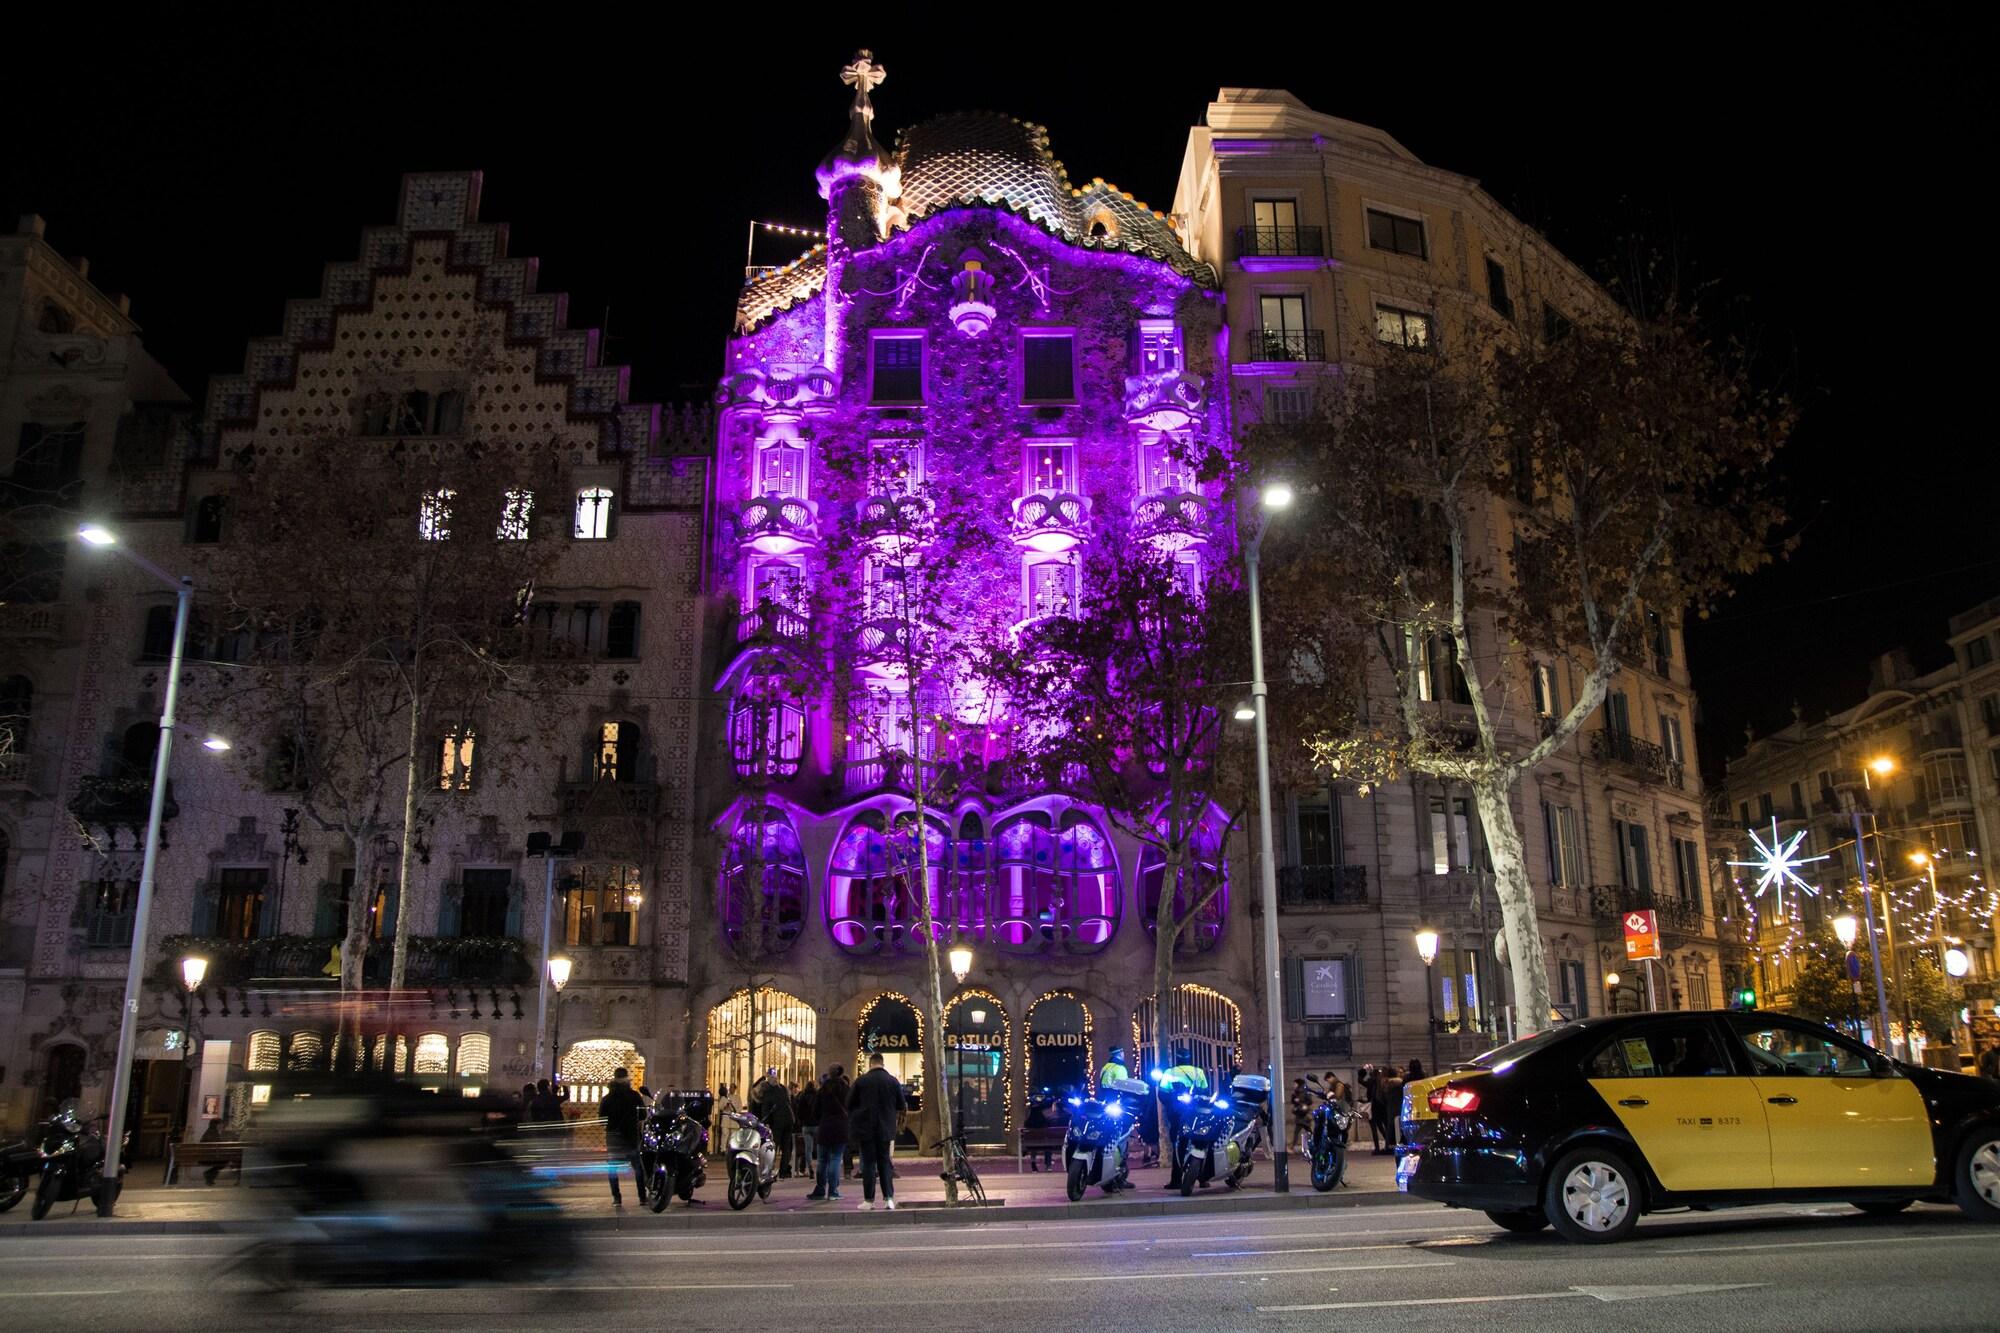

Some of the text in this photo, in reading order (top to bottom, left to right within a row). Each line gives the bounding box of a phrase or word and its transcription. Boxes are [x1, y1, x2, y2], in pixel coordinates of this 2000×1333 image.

[1631, 918, 1640, 926] M
[870, 1034, 909, 1047] CASA
[1676, 1117, 1696, 1125] TAXI
[1718, 1117, 1741, 1125] 8373
